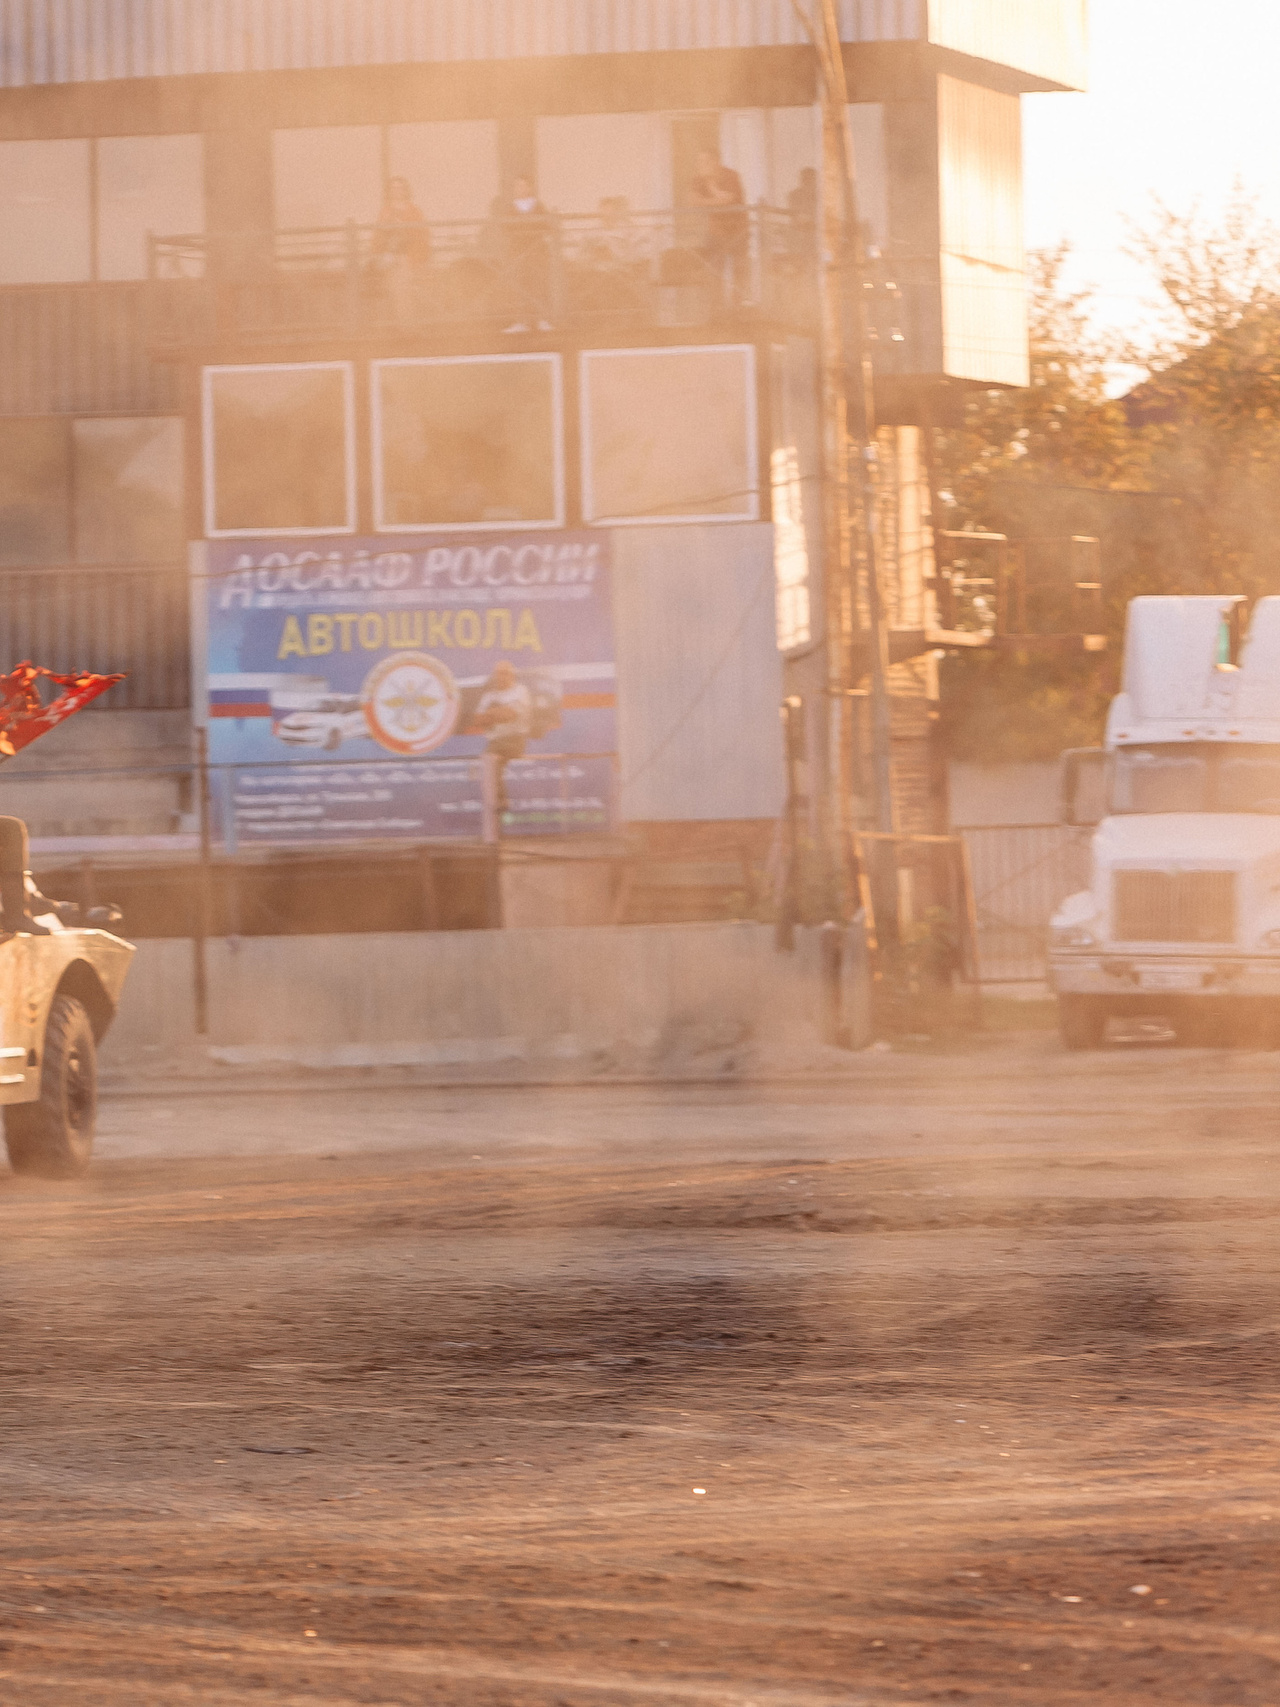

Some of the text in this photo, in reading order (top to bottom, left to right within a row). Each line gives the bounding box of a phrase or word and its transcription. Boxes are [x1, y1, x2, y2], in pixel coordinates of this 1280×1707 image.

[220, 551, 413, 609] ДОСААФ
[419, 542, 599, 587] РОССИИ
[276, 607, 543, 661] АВТОШКОЛА
